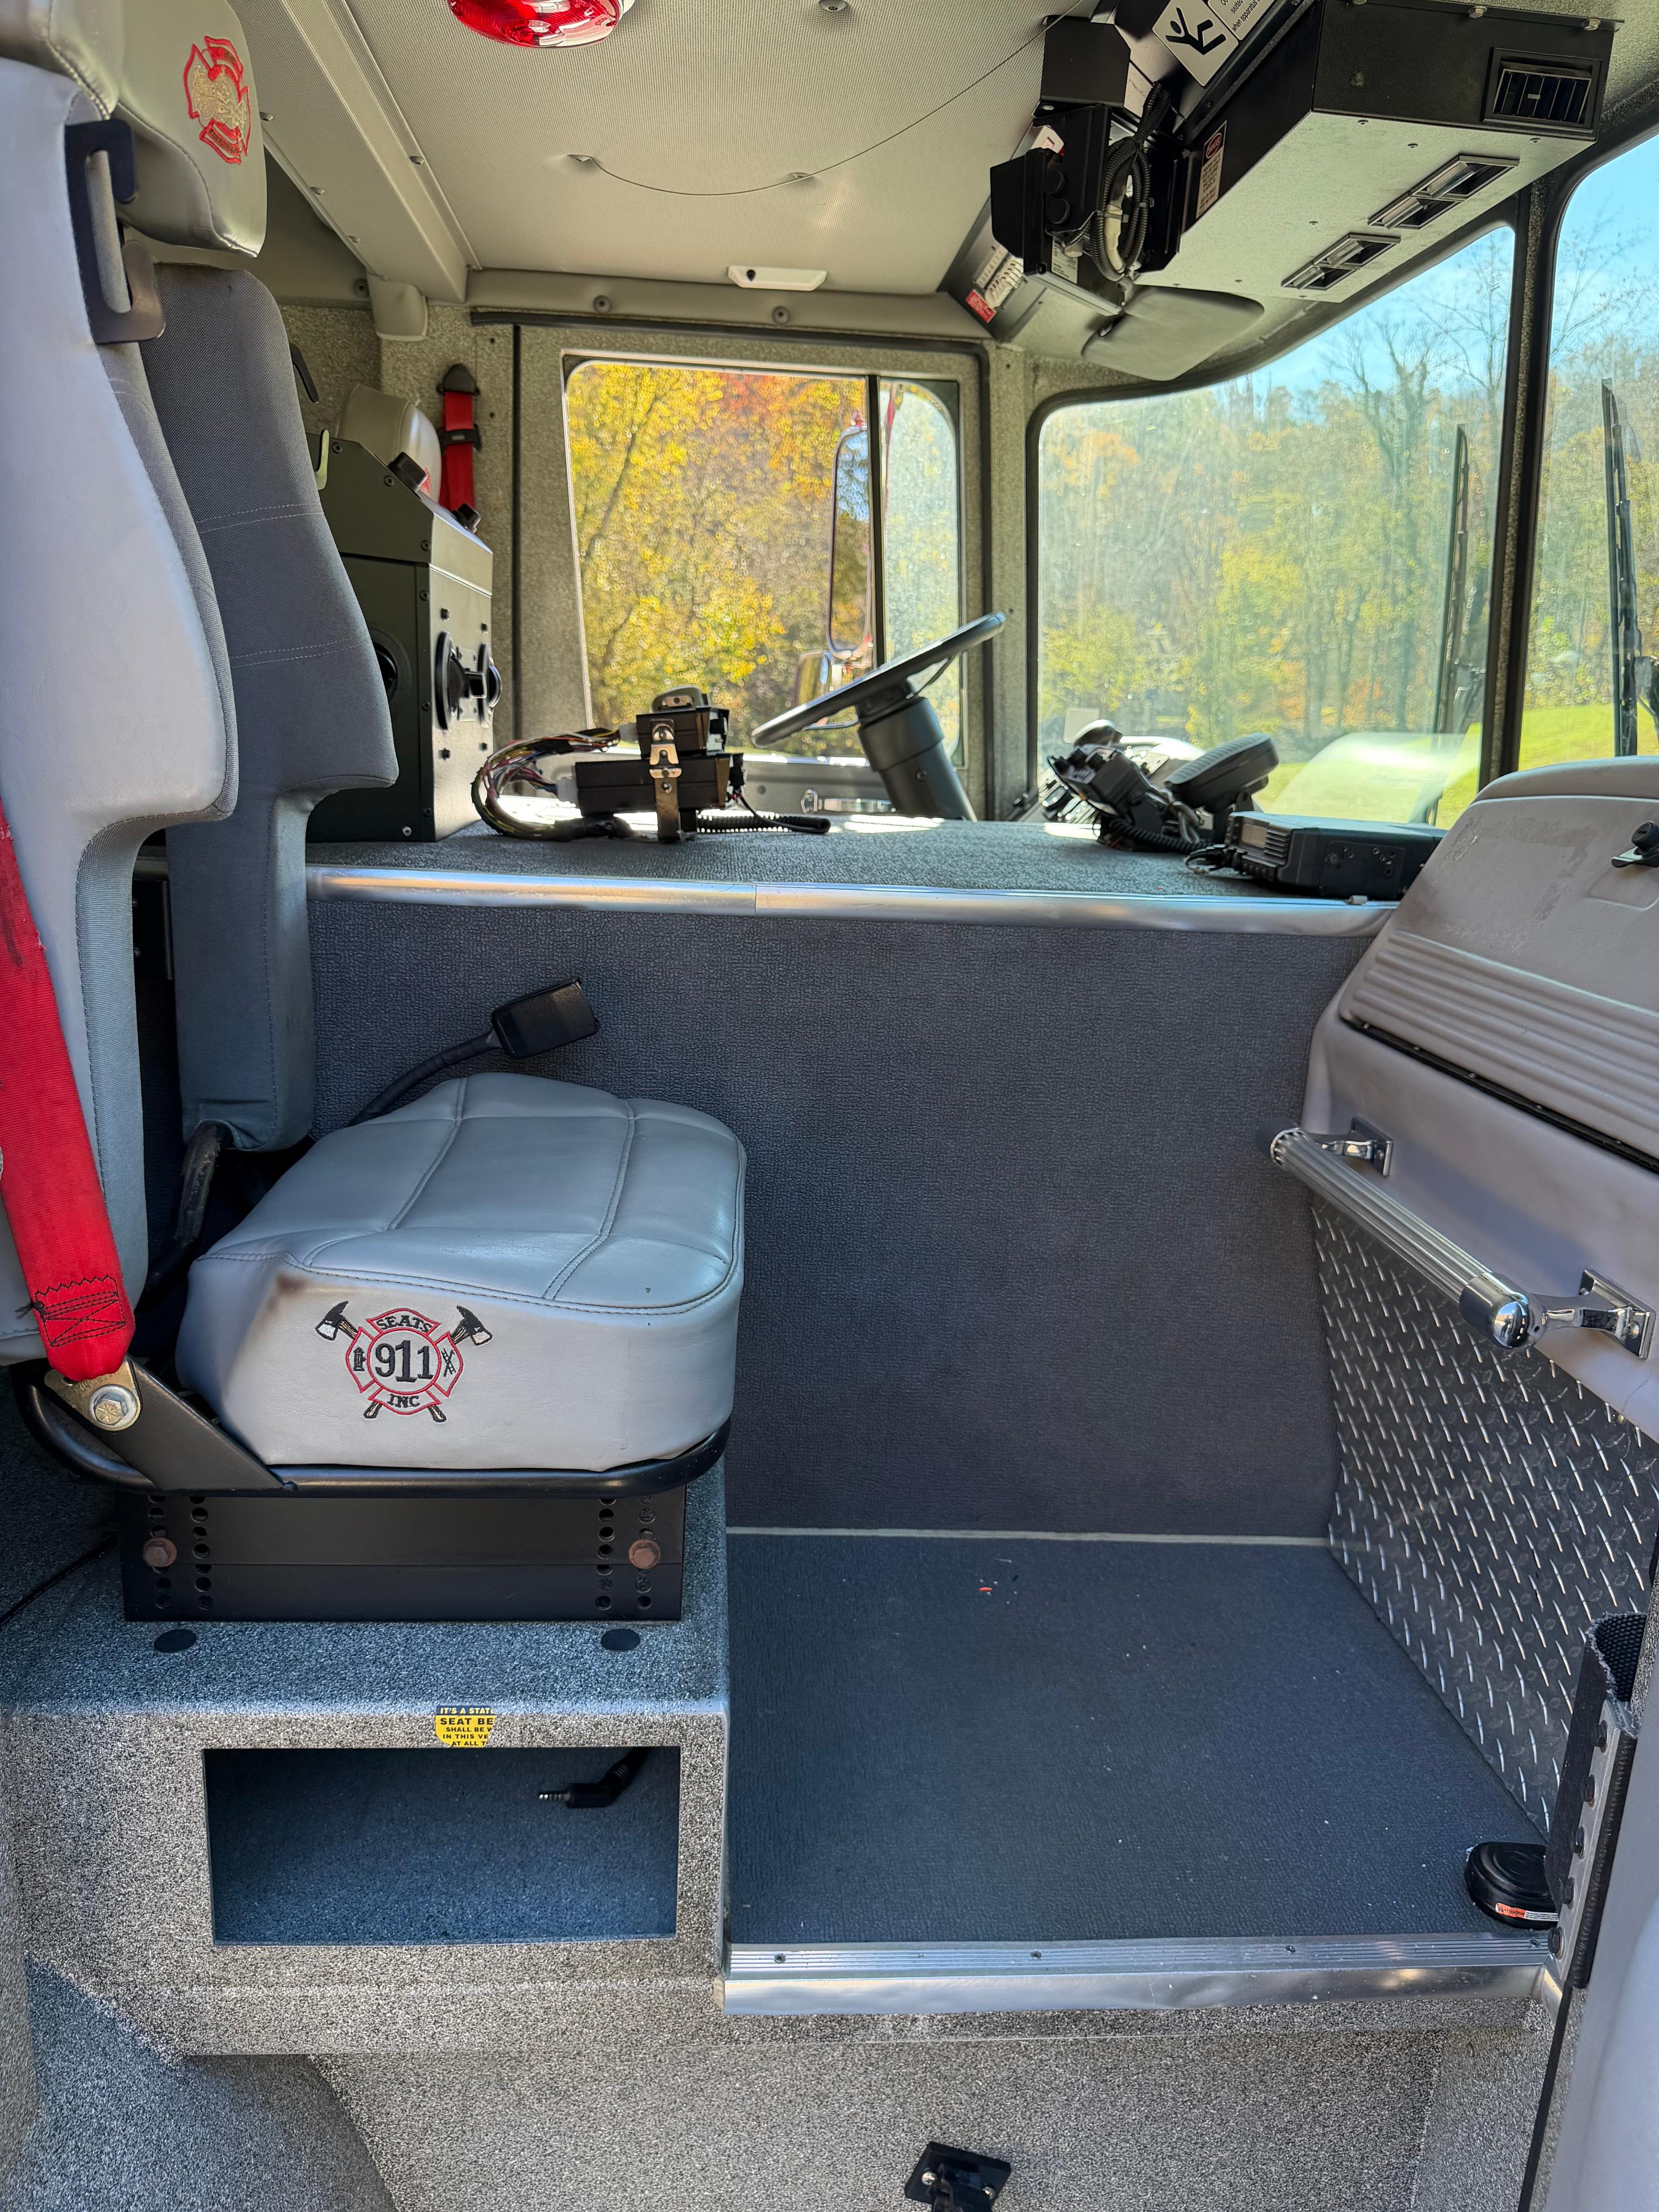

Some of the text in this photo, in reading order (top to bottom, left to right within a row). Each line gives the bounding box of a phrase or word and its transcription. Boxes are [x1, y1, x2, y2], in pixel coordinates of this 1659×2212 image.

[1232, 0, 1258, 32] when apparatus
[376, 1315, 432, 1333] SEATS
[375, 1340, 434, 1383] 911
[388, 1394, 420, 1408] INC
